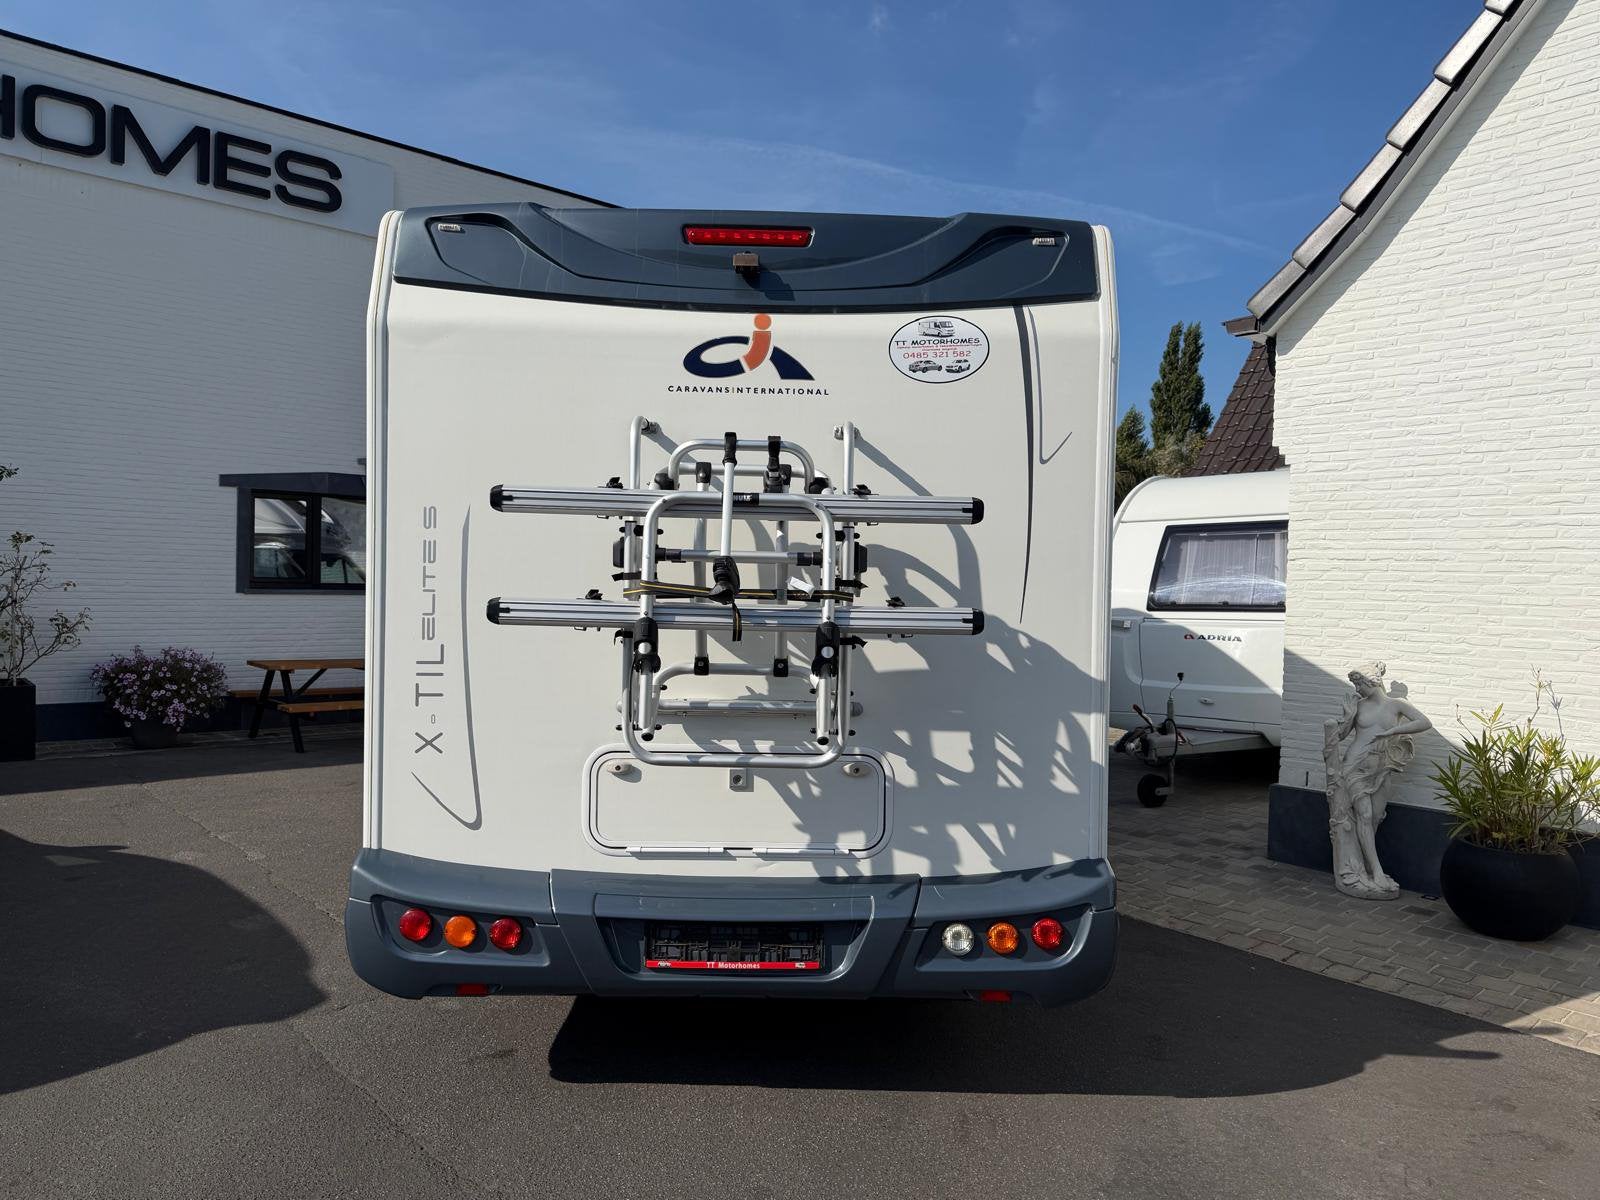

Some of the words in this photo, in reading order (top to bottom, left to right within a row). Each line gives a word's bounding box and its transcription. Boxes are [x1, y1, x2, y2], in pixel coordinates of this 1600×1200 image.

[0, 74, 342, 213] OMES
[911, 338, 980, 346] MOTORHOMES
[903, 352, 929, 360] 0485
[932, 351, 949, 359] 321
[952, 350, 972, 358] 582
[1197, 634, 1243, 642] ADRIA
[706, 961, 715, 969] TT
[718, 961, 760, 969] Motorhomes
